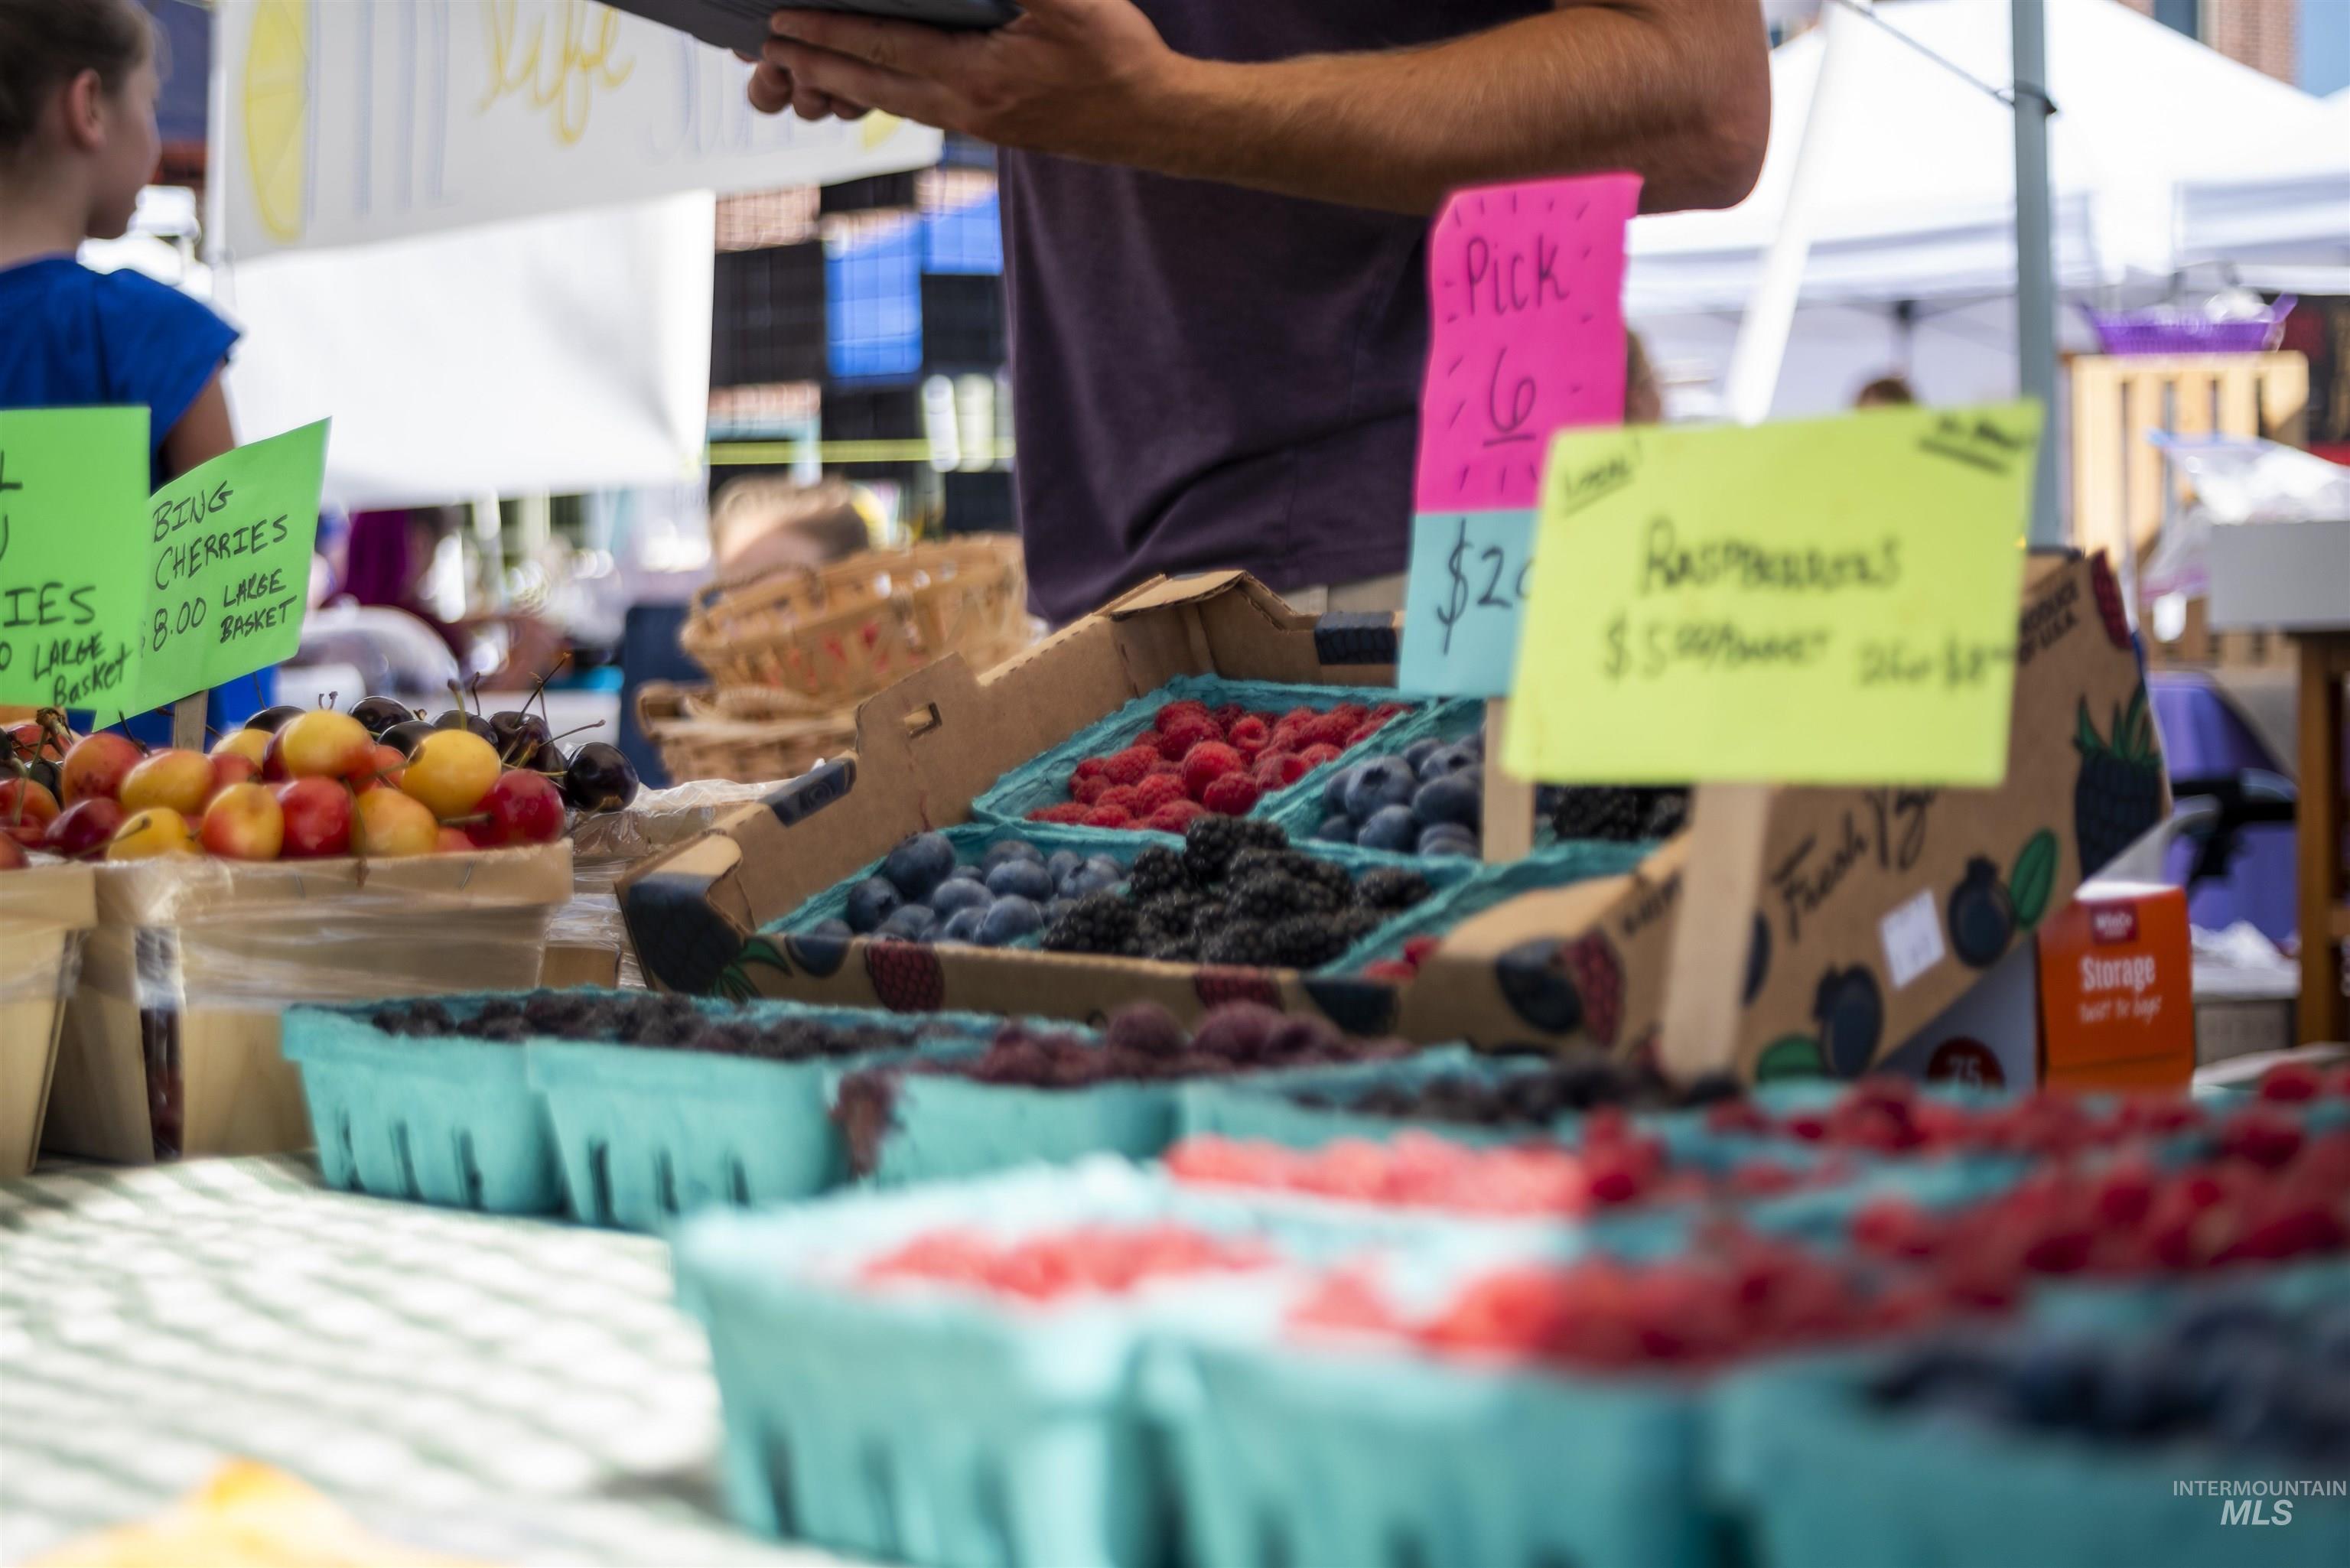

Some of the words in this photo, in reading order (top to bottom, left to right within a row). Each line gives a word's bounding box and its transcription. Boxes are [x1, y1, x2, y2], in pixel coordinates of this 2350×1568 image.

[1488, 346, 1538, 434] 6
[153, 480, 233, 543] BING
[155, 514, 288, 590] CHERRIES
[141, 597, 207, 652] 8.00
[223, 568, 286, 607] LARGE
[220, 595, 298, 644] BASKET
[33, 632, 106, 681] LARGE
[2079, 955, 2156, 993] Storage
